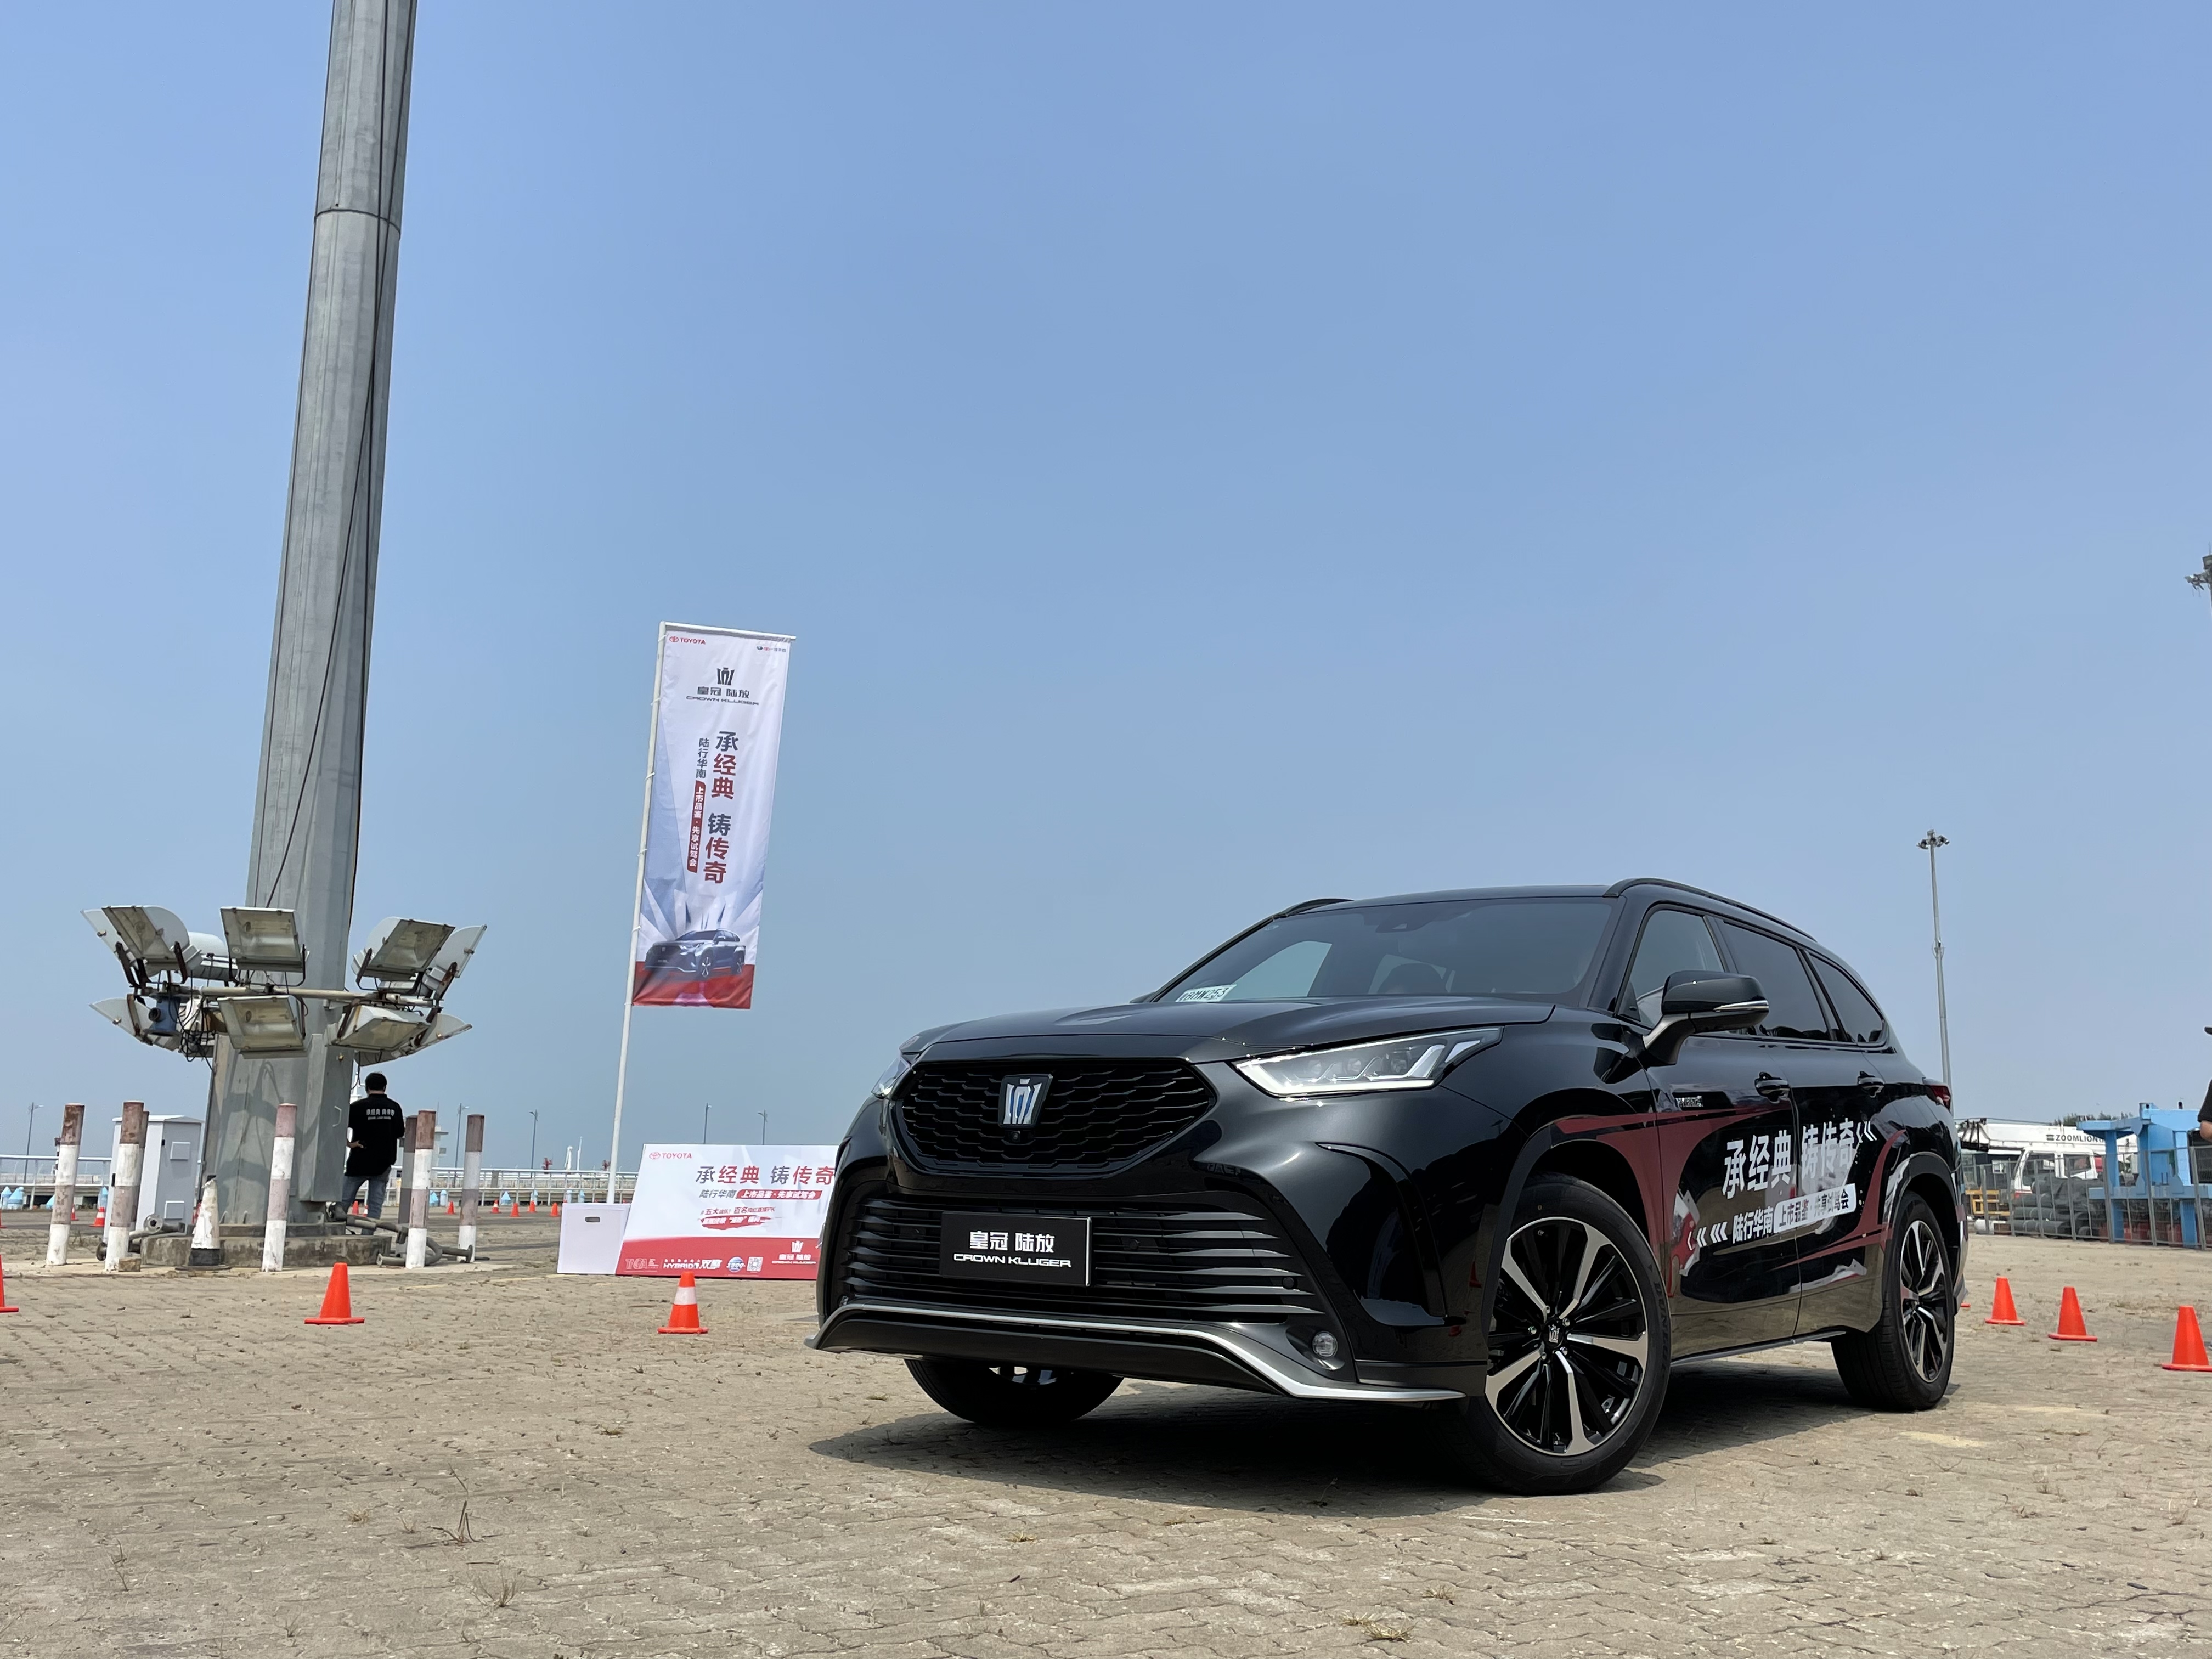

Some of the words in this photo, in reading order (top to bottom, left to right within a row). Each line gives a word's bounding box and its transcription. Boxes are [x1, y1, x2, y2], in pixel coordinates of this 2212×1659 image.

[697, 686, 722, 696] 皇冠
[726, 688, 749, 698] 陆放
[696, 738, 709, 778] 陆行华南
[711, 731, 739, 799] 承经典
[703, 812, 731, 884] 铸传奇
[1722, 1130, 1791, 1199] 承经典
[1801, 1118, 1855, 1180] 铸传奇
[696, 1165, 760, 1184] 承经典
[770, 1165, 835, 1185] 铸传奇
[699, 1189, 737, 1199] 陆行华南
[1733, 1206, 1774, 1244] 陆行华南
[969, 1231, 1008, 1251] 皇冠
[1015, 1232, 1055, 1253] 陆放
[953, 1253, 1005, 1264] CROWN
[1008, 1256, 1071, 1267] KLUGER
